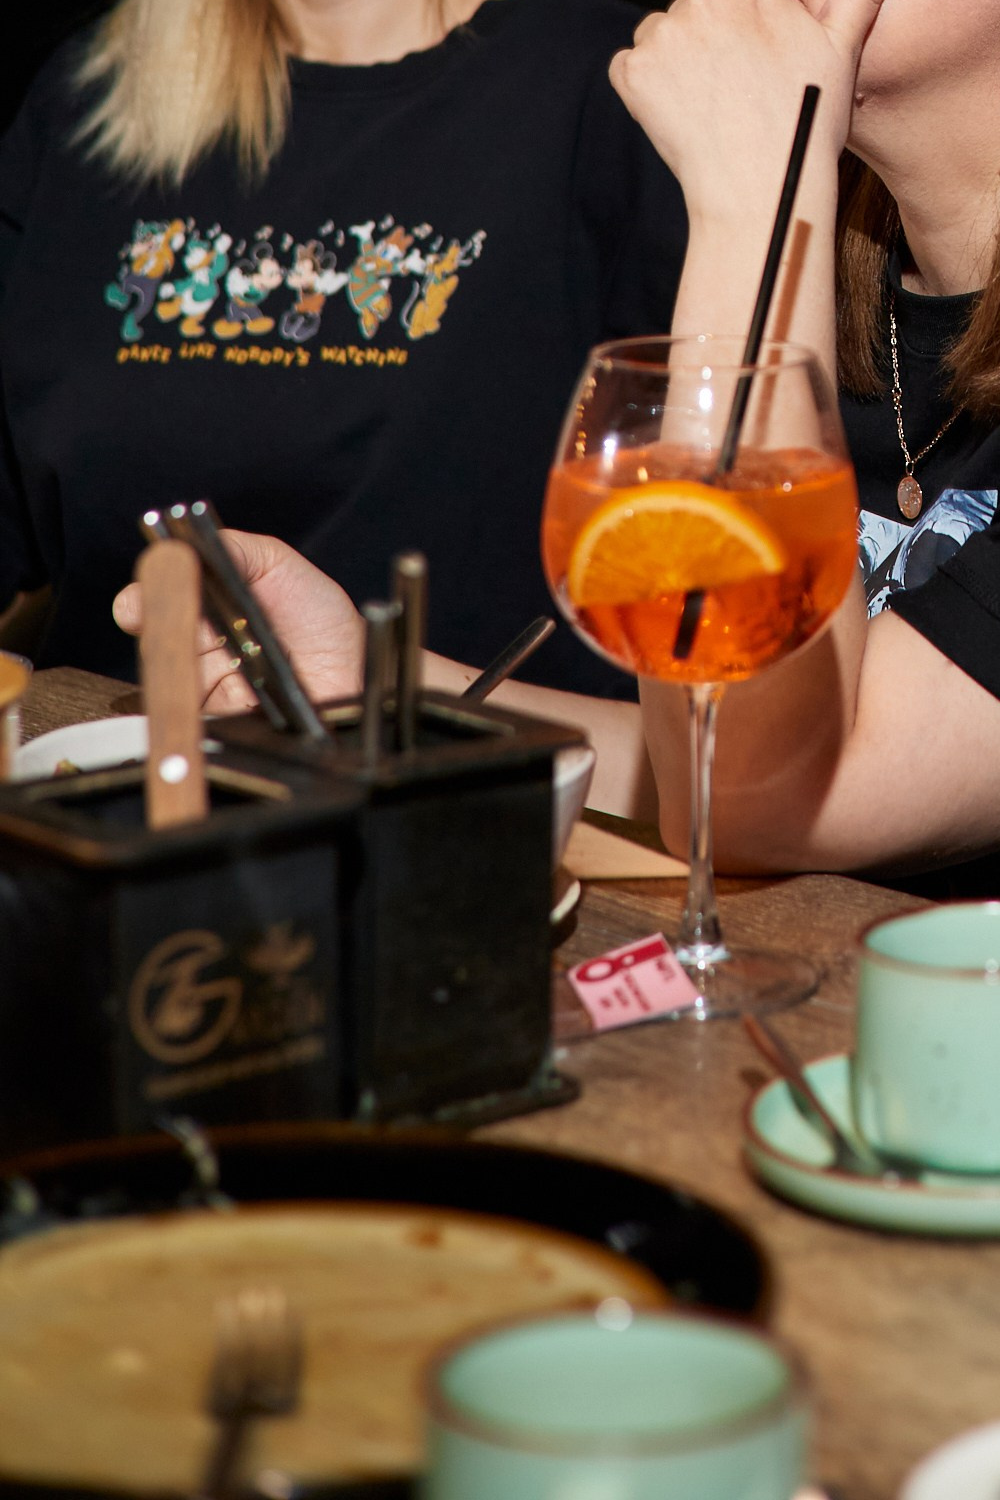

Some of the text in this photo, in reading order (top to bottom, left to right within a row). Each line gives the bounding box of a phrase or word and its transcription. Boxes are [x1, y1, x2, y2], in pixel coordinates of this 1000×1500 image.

[117, 341, 408, 367] DANCE LIKE NOBODY'S WATCHING
